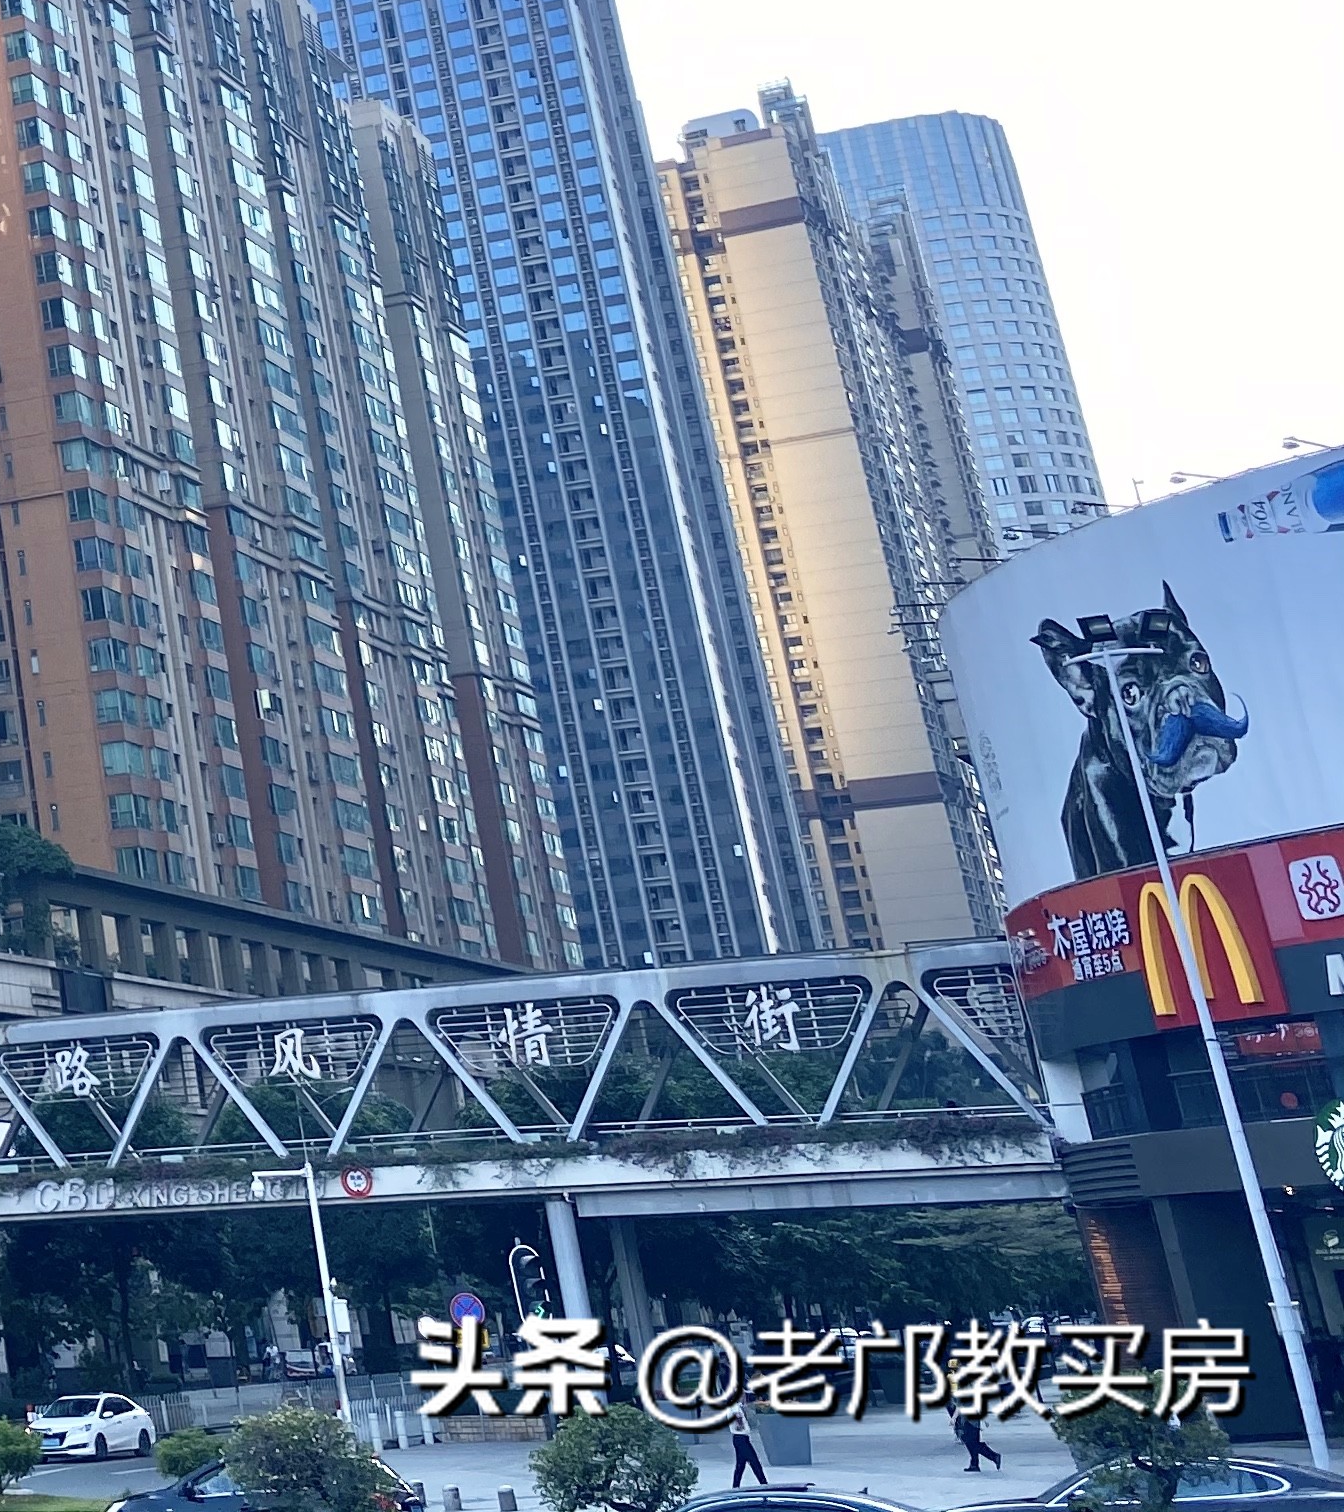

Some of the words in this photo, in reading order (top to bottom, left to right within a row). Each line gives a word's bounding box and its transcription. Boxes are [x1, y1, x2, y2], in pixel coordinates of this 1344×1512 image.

[1047, 908, 1131, 961] 木屋烧烤
[1071, 949, 1125, 981] 通宵至5点
[34, 1177, 114, 1213] CBD
